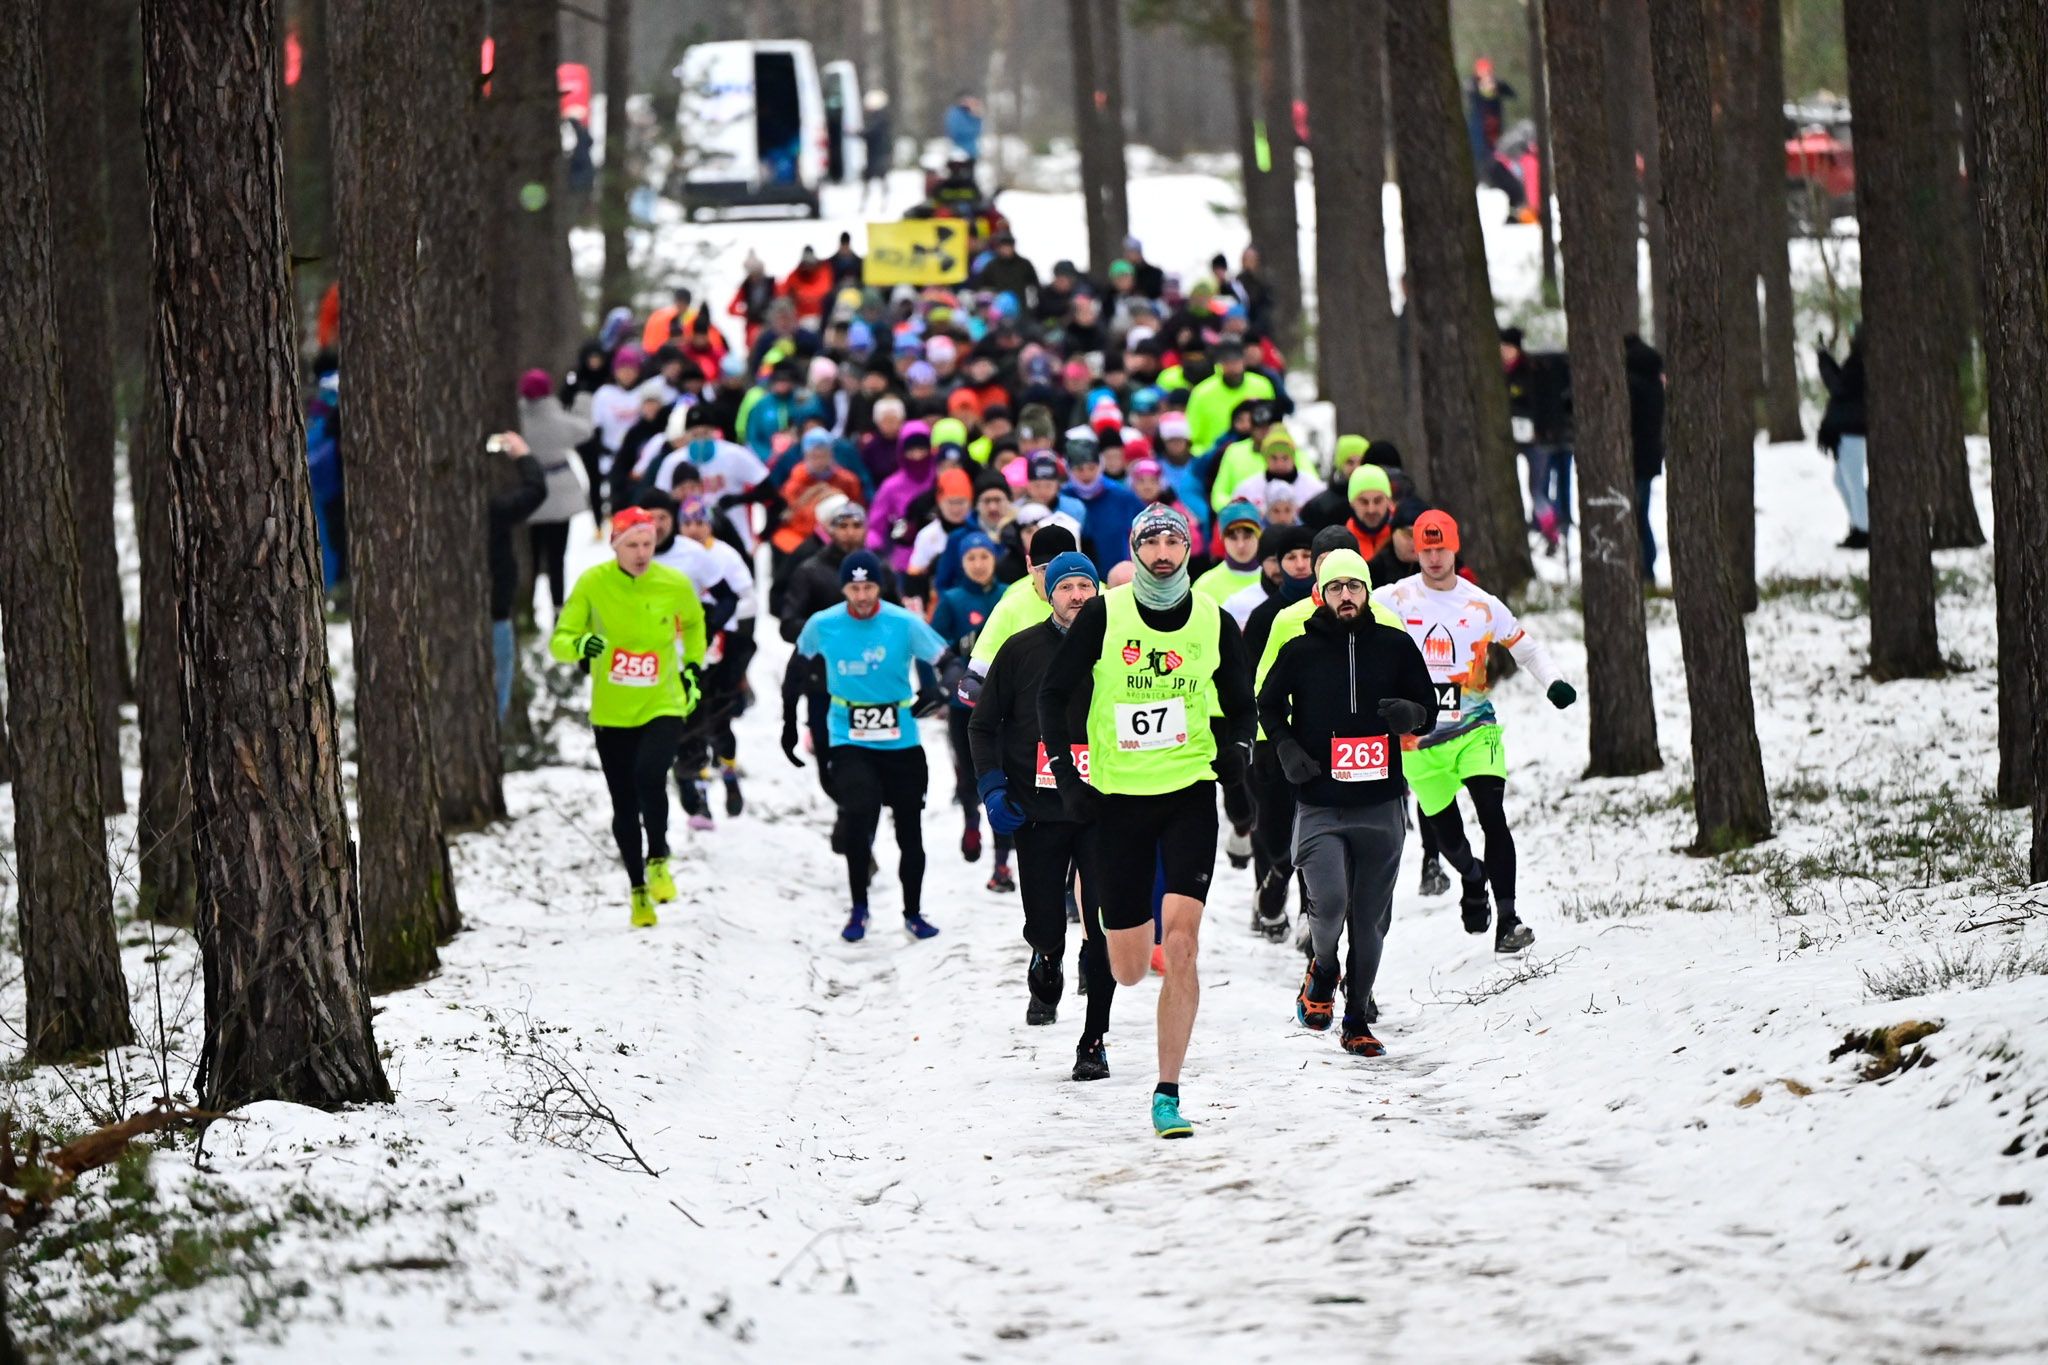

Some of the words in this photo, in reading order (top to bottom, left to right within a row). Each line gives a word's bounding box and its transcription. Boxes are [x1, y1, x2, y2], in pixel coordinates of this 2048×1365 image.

[613, 653, 656, 676] 256
[1127, 675, 1152, 689] RUN
[1171, 677, 1186, 690] JP
[853, 707, 896, 729] 524
[1131, 707, 1168, 736] 67
[1337, 742, 1385, 768] 263
